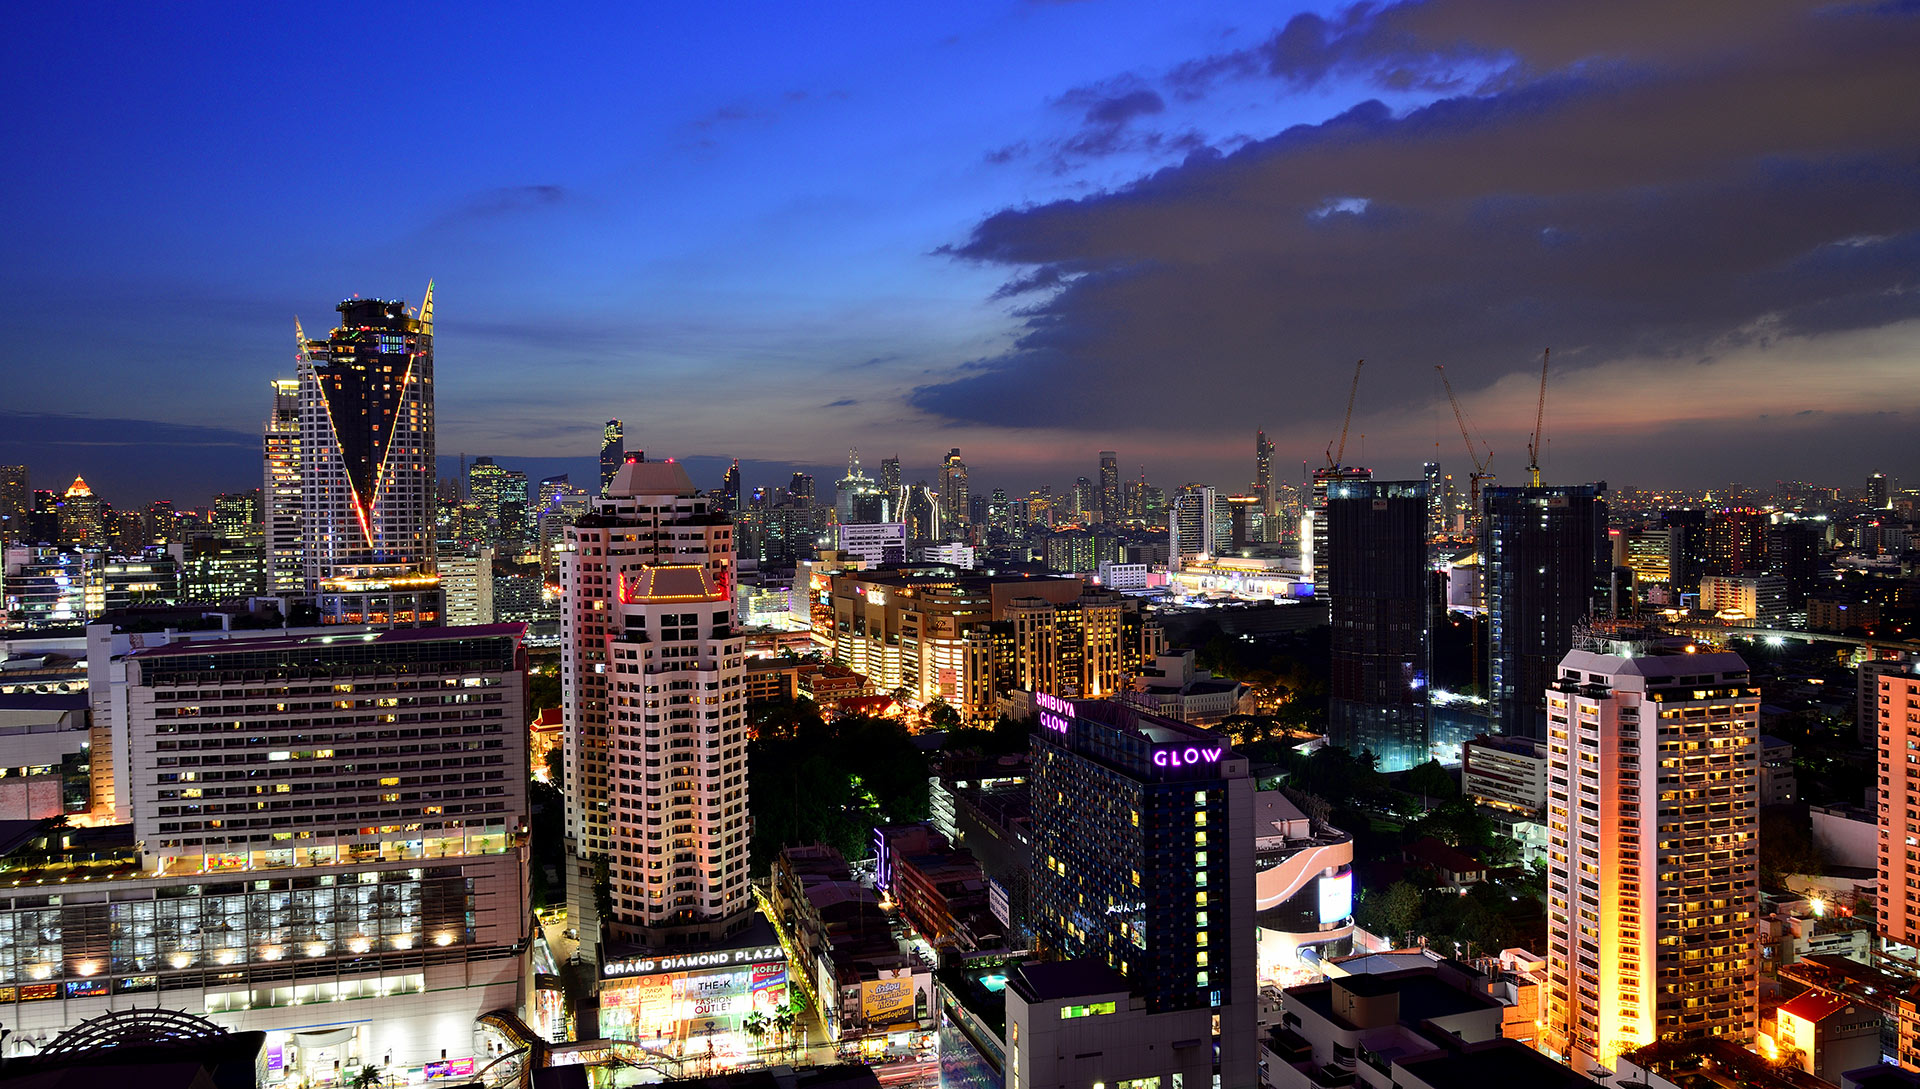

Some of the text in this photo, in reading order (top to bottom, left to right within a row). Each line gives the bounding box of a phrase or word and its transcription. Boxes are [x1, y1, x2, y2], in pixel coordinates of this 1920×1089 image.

[1036, 691, 1075, 719] SHIBUYA
[1040, 711, 1068, 734] GLOW
[1154, 747, 1222, 767] GLOW
[604, 946, 783, 975] GRAND DIAMOND PLAZA
[753, 963, 785, 975] KOREA
[698, 980, 731, 991] THE-K
[695, 995, 732, 1005] FASHION
[694, 1002, 732, 1015] OUTLET
